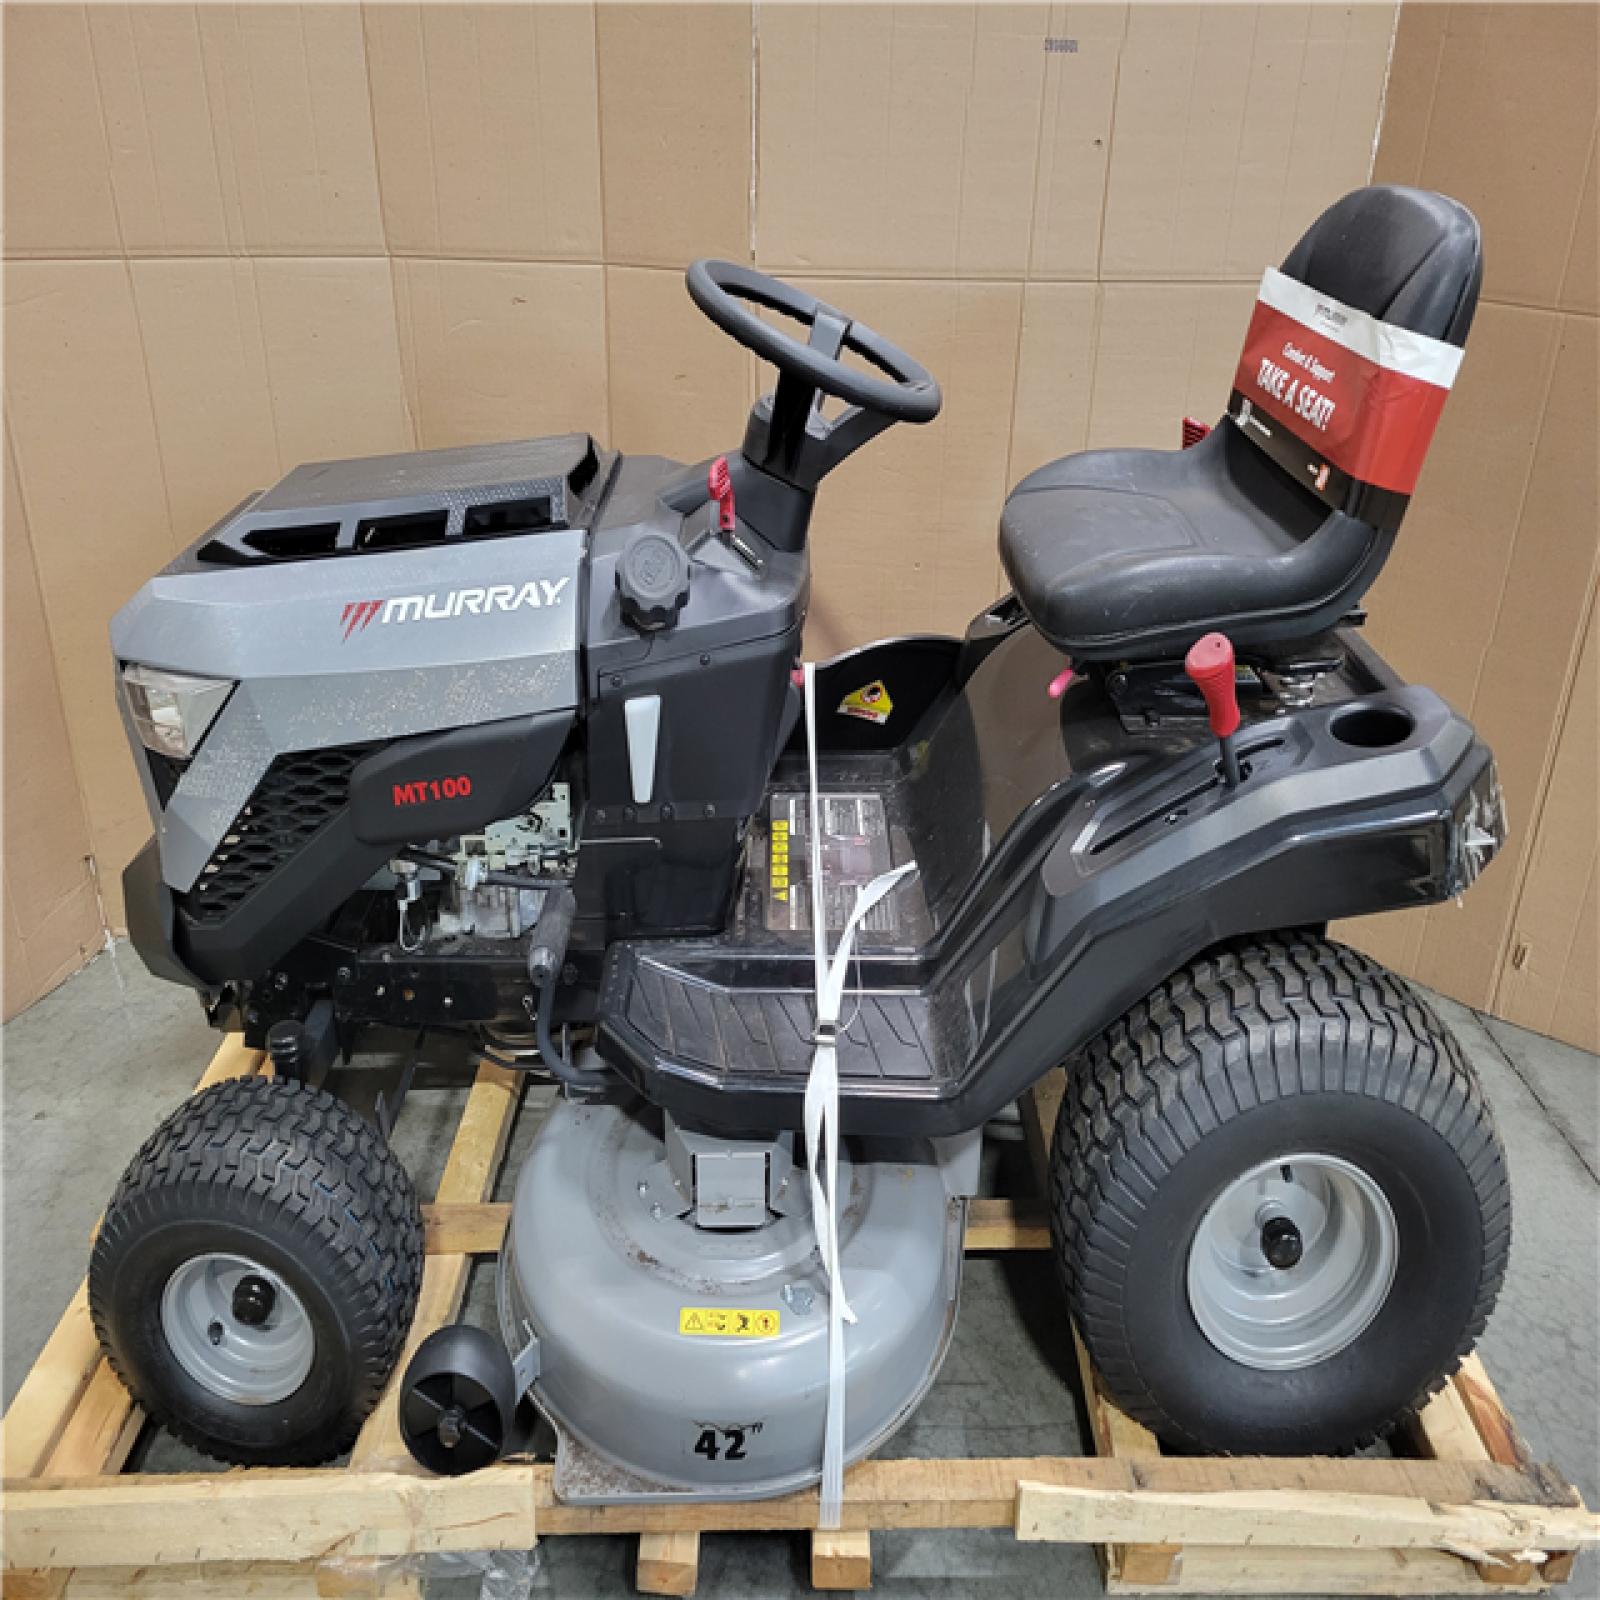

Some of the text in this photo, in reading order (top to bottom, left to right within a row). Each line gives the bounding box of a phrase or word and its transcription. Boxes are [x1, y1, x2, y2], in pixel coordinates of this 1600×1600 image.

[1257, 357, 1290, 401] TAKE
[1283, 379, 1300, 409] A
[1295, 385, 1336, 431] SEAT!
[382, 577, 571, 624] MURRAY
[392, 775, 472, 806] MT100
